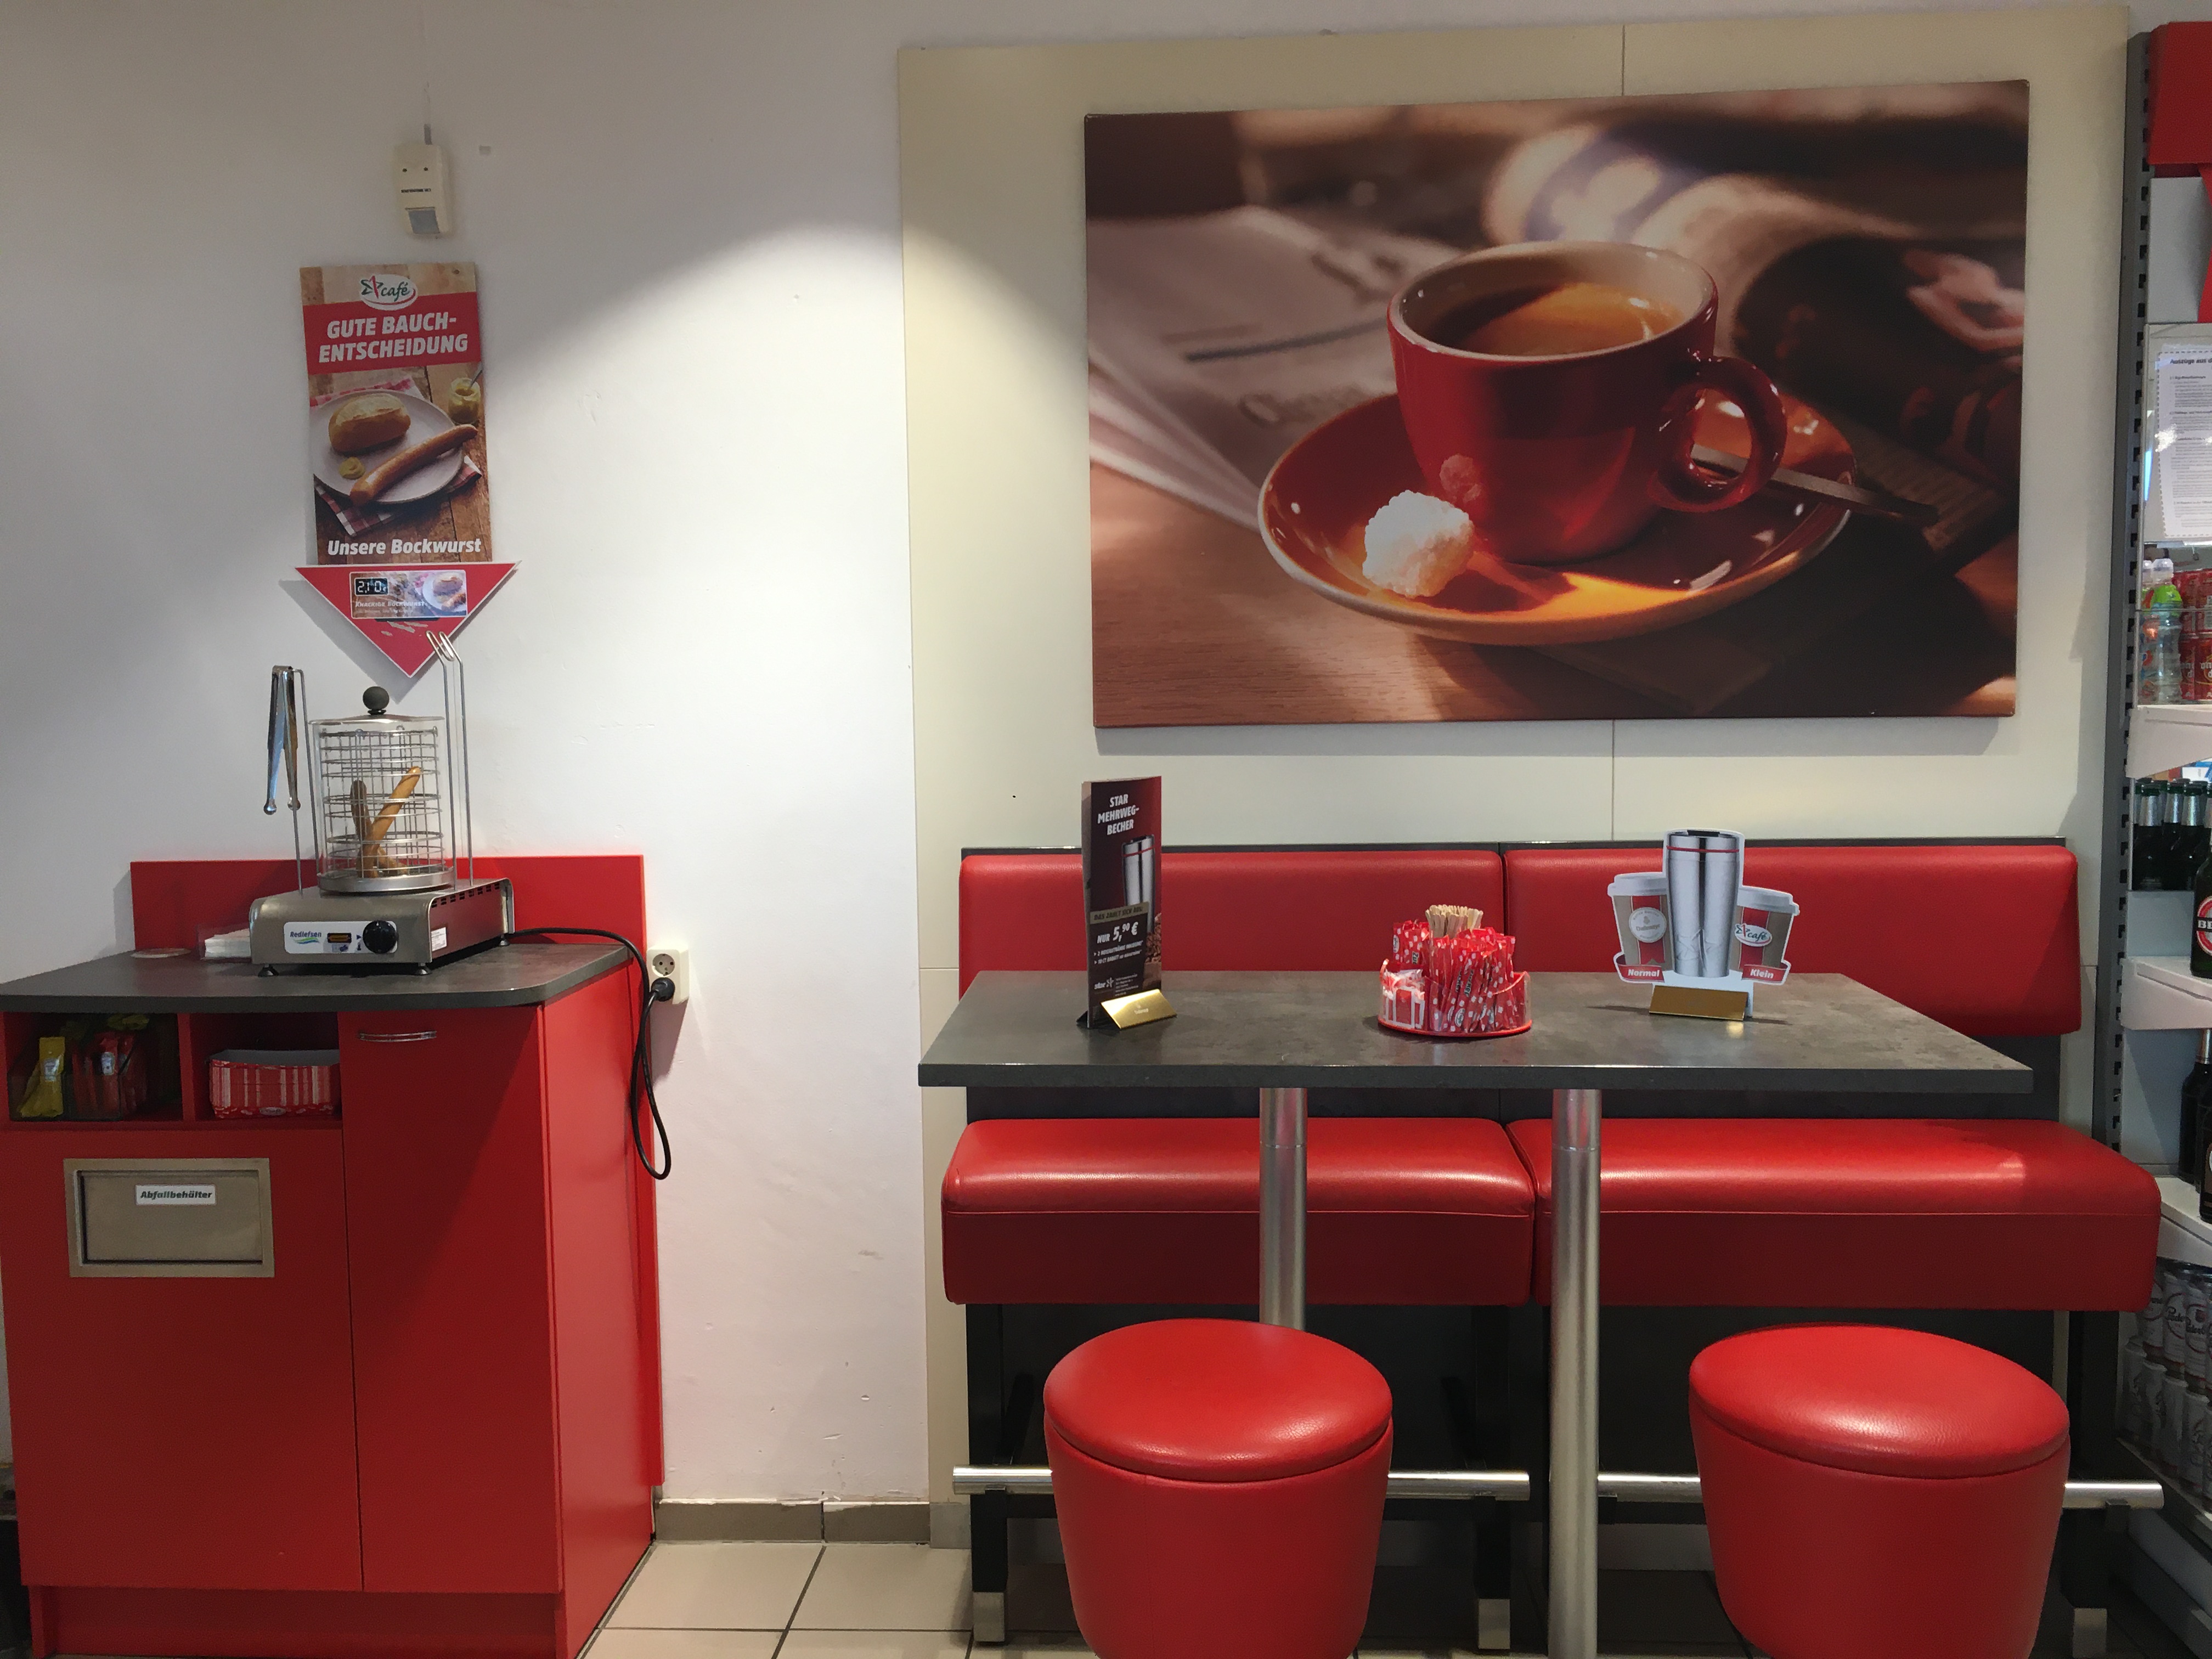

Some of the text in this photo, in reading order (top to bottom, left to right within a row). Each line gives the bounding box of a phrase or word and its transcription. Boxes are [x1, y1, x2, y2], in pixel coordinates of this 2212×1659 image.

[381, 281, 410, 302] café
[327, 312, 456, 339] GUTE BAUCH-
[318, 334, 468, 363] ENTSCHEIDUNG
[328, 538, 481, 556] Unsere Bockwurst
[1109, 794, 1128, 808] STAR
[1097, 805, 1139, 824] MEHRWEG-
[1107, 819, 1134, 836] BECHER
[1097, 933, 1110, 944] NUR
[1628, 969, 1660, 977] Normal
[1750, 969, 1774, 979] Klein
[140, 1190, 212, 1200] Abfallbehälter
